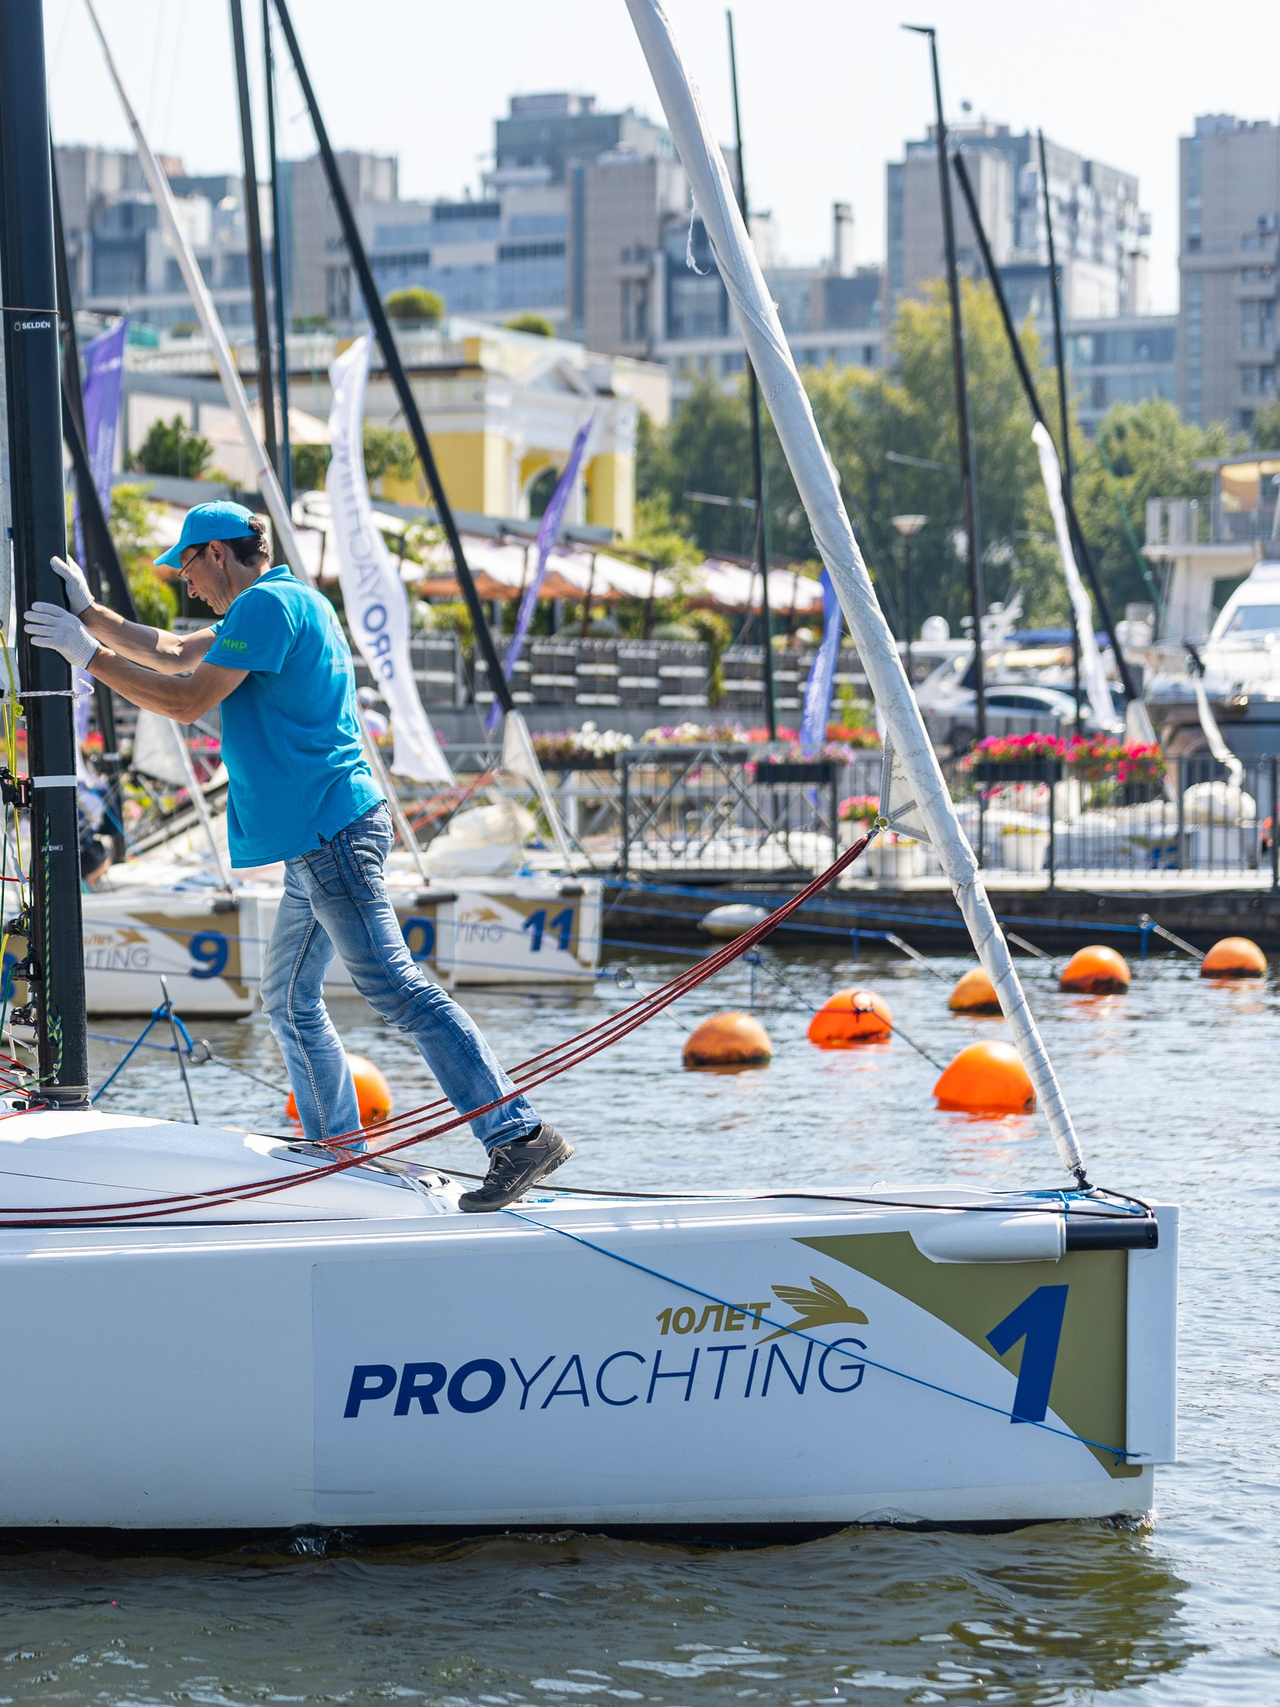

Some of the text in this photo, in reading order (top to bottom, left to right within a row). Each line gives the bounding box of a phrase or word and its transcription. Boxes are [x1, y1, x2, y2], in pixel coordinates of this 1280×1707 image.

[221, 637, 248, 650] МИР
[523, 908, 574, 952] 11
[189, 929, 229, 979] 9
[655, 1301, 771, 1336] 10ЛЕТ
[342, 1337, 868, 1418] PROYACHTING
[985, 1284, 1069, 1424] 1
